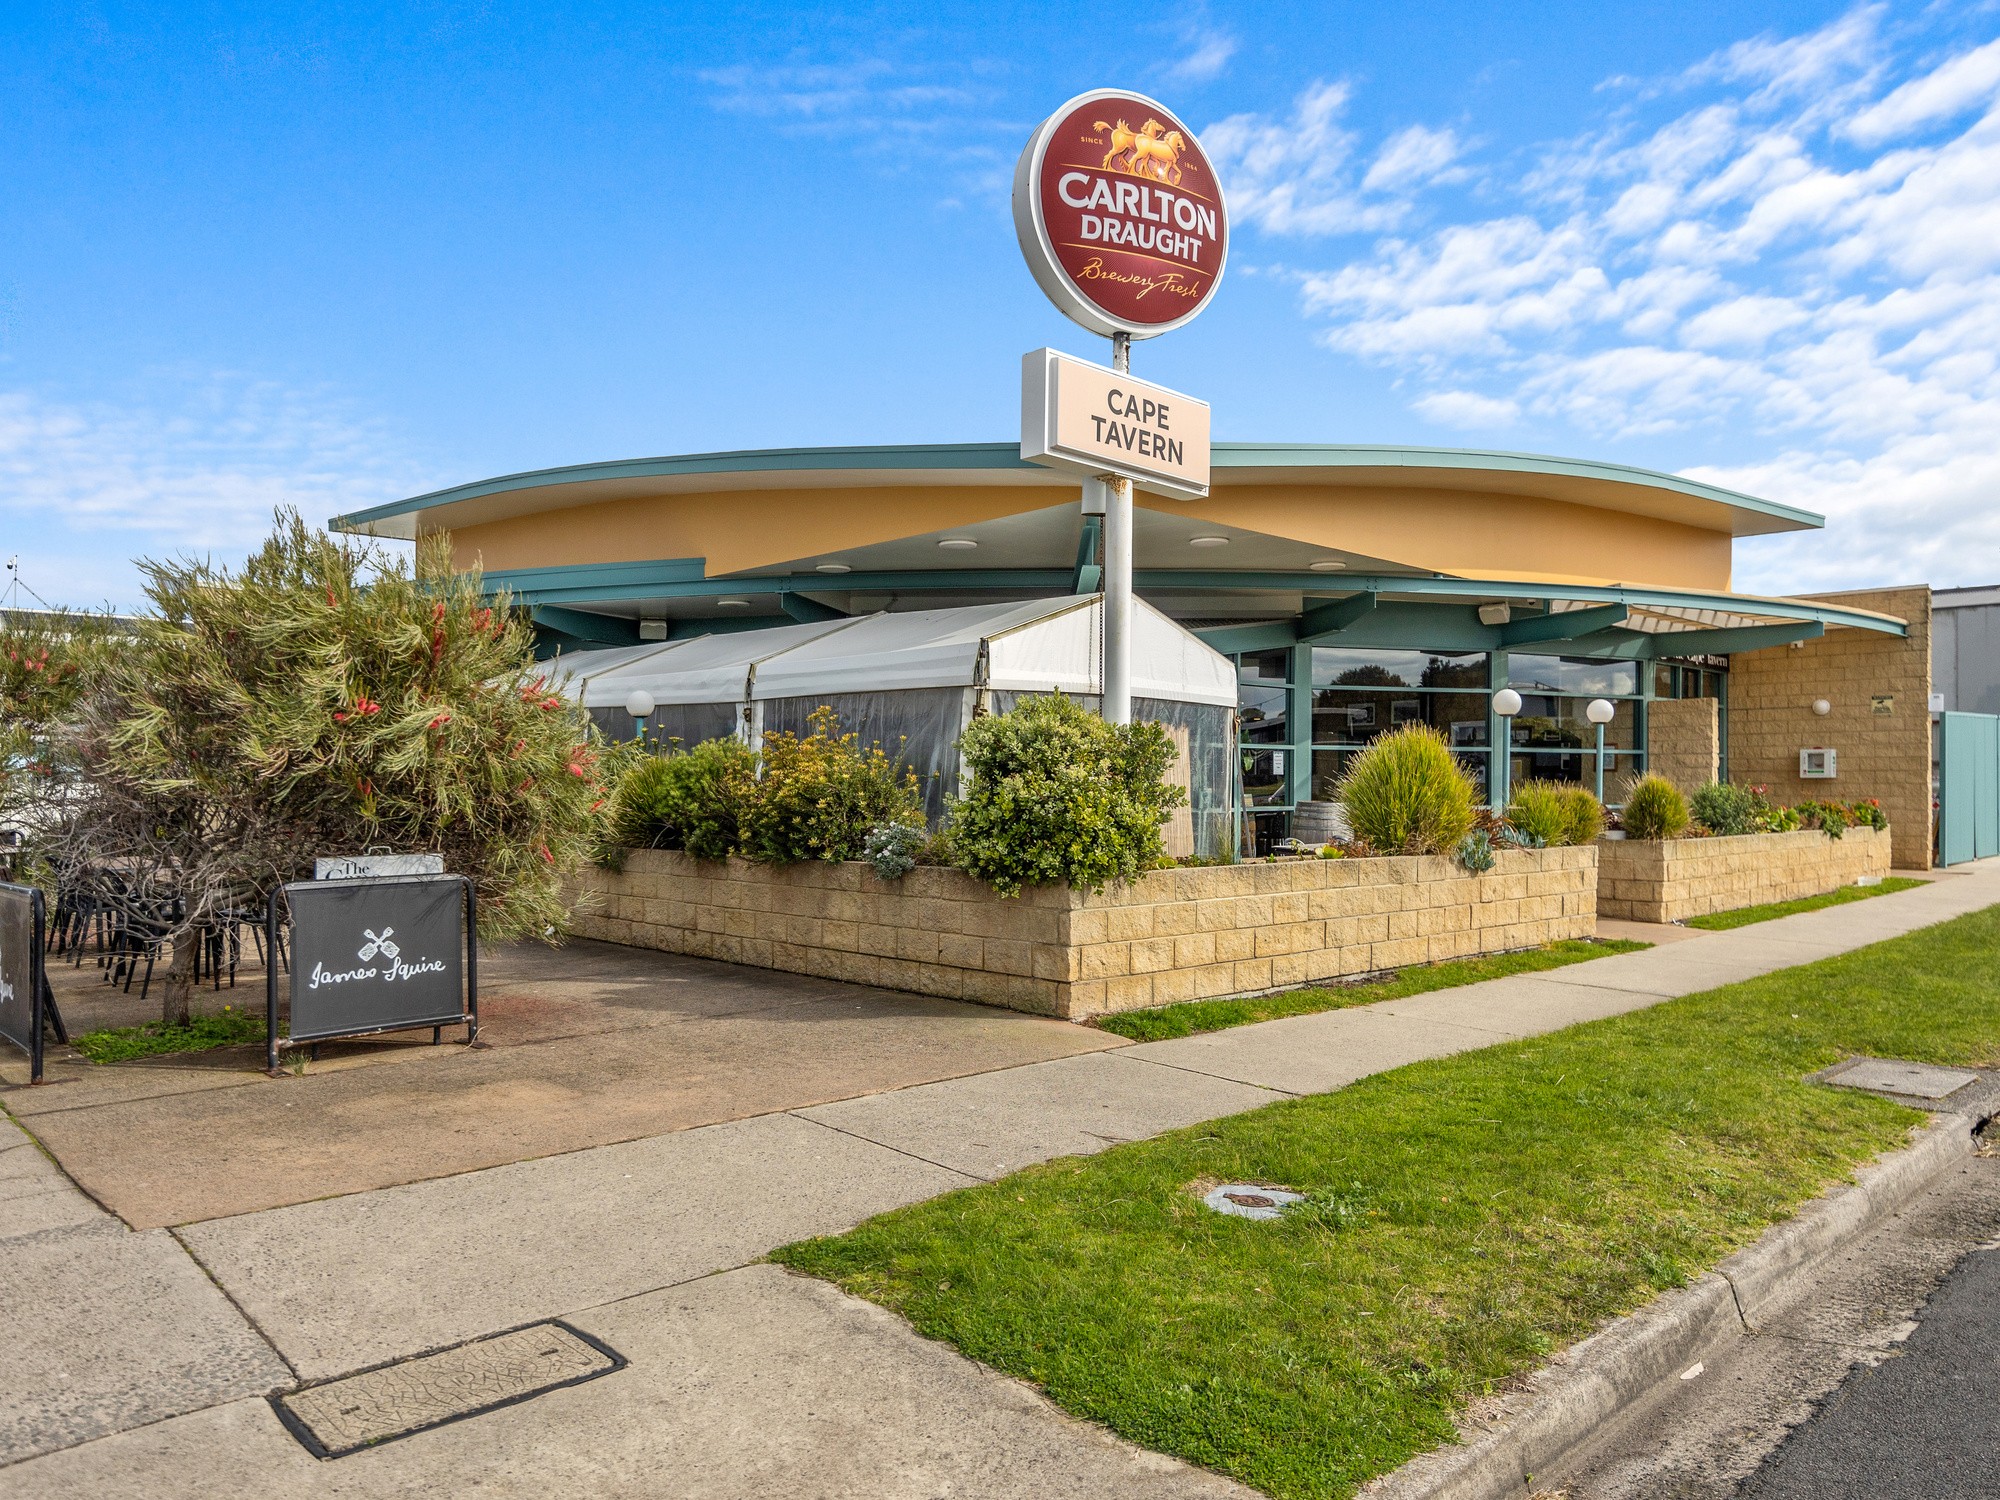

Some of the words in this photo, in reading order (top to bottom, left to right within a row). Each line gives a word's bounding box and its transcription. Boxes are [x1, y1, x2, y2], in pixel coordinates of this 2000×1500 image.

[1081, 136, 1103, 145] SINCE
[1058, 171, 1216, 242] CARLTON
[1080, 214, 1202, 263] DRAUGHT
[1077, 257, 1153, 300] Brewery
[1158, 273, 1198, 298] Fresh
[1107, 388, 1169, 431] CAPE
[1091, 414, 1183, 466] TAVERN
[342, 862, 370, 875] The
[309, 961, 377, 989] James
[382, 956, 446, 981] Squire
